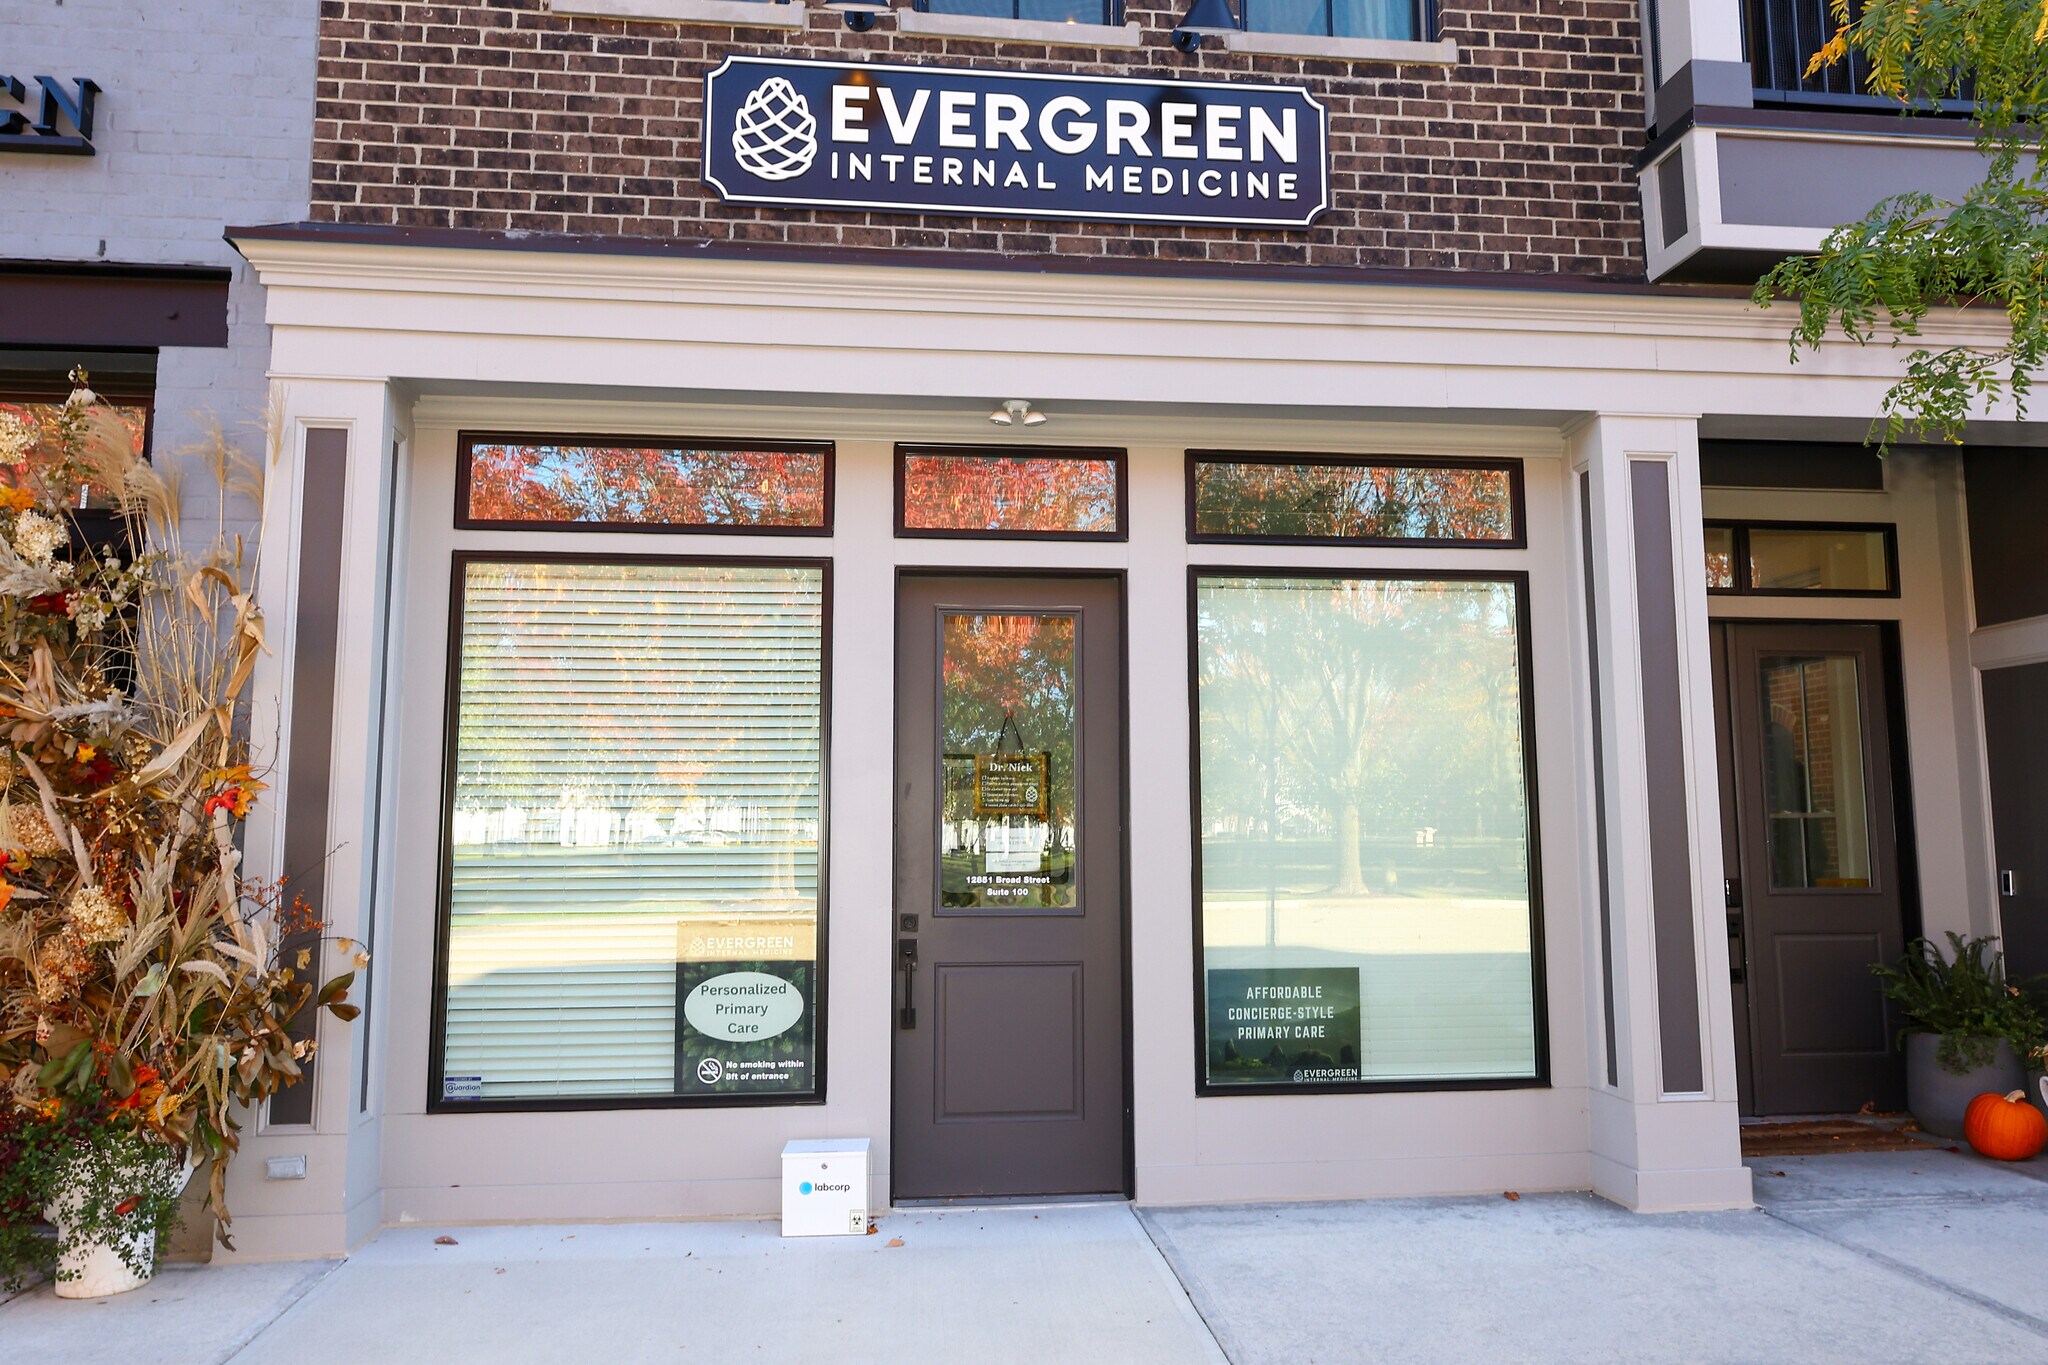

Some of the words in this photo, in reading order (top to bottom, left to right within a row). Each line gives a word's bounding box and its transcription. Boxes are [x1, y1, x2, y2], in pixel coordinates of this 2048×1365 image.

[831, 84, 1299, 164] EVERGREEN
[831, 151, 1057, 190] INTERNAL
[1085, 165, 1299, 201] MEDICINE
[990, 763, 1006, 771] Dr.
[1008, 763, 1033, 772] Nick
[996, 876, 1021, 884] Broad
[1024, 876, 1050, 884] Street
[987, 888, 1009, 896] Suite
[1012, 888, 1029, 896] 100
[706, 936, 794, 949] EVERGREEN
[701, 983, 787, 996] Personalized
[1246, 986, 1322, 999] AFFORDABLE
[716, 1003, 769, 1017] Primary
[1228, 1006, 1334, 1021] CONCIERGE-STYLE
[728, 1022, 759, 1034] Care
[1238, 1026, 1290, 1040] PRIMARY
[1294, 1025, 1325, 1038] CARE
[726, 1061, 738, 1069] No
[740, 1060, 776, 1069] smoking
[778, 1060, 804, 1068] within
[751, 1072, 789, 1080] entrance
[1303, 1068, 1358, 1077] EVERGREEN
[446, 1082, 480, 1094] Guardian
[814, 1183, 850, 1192] labcorp
